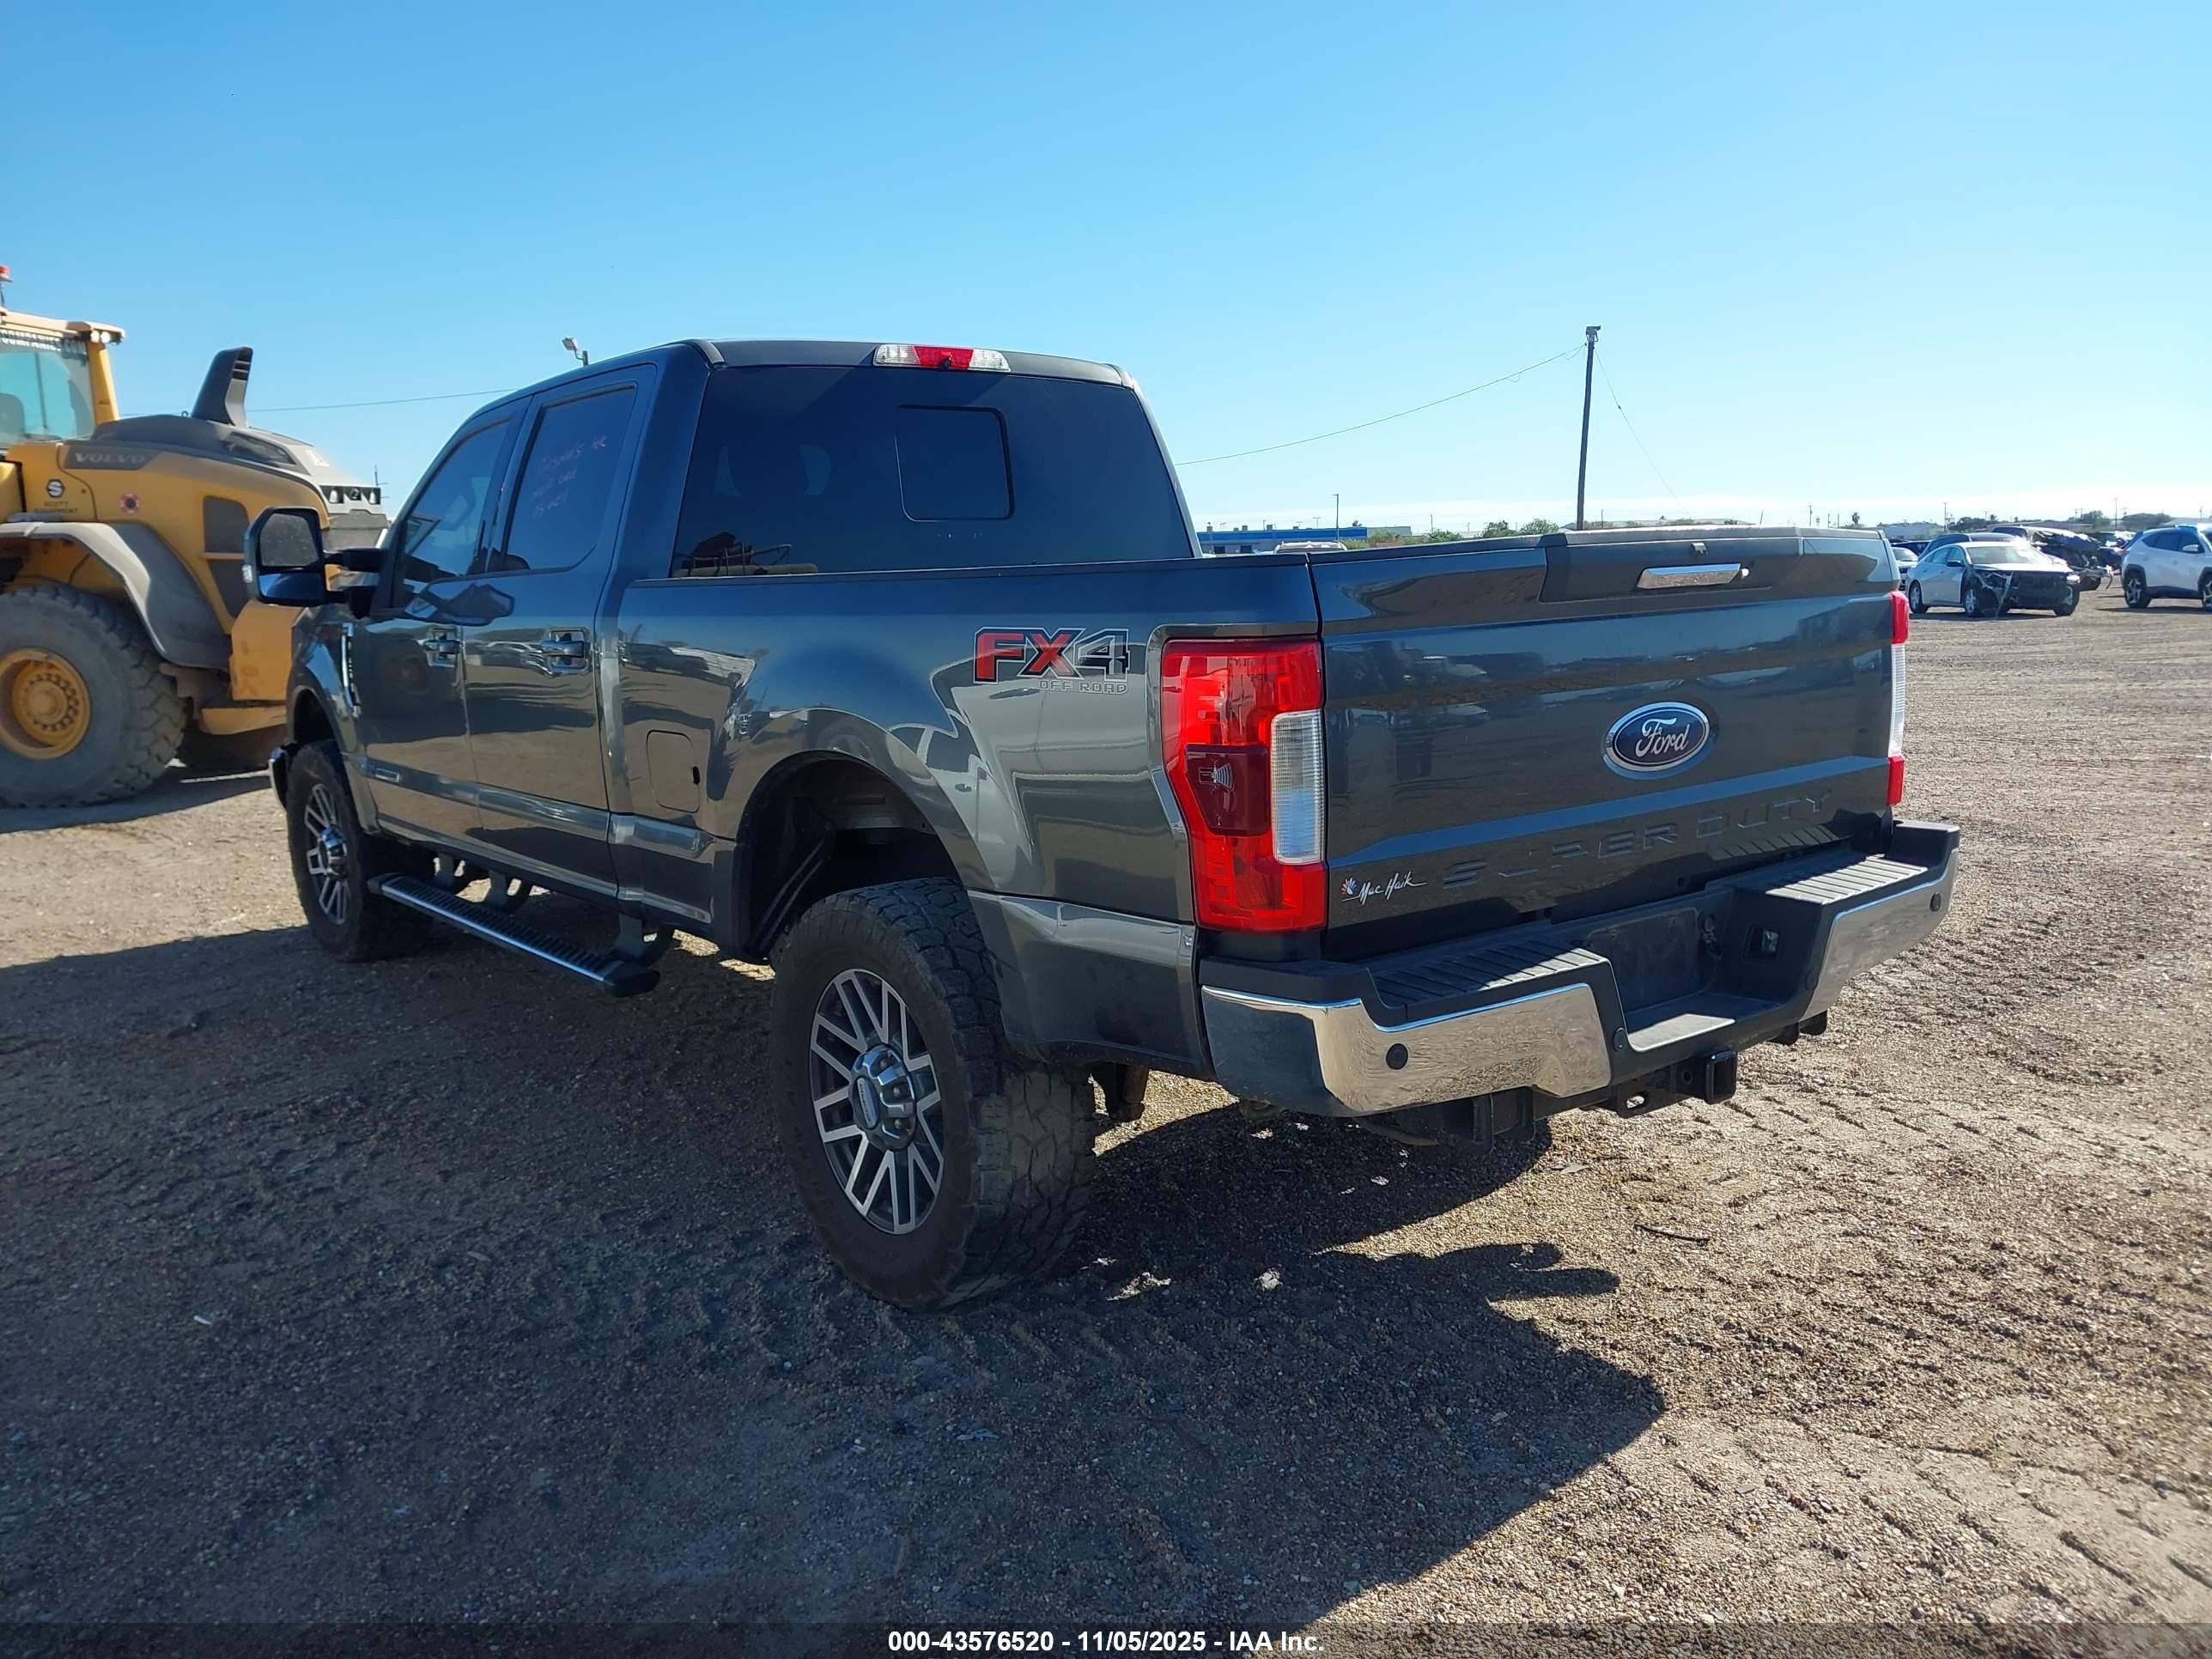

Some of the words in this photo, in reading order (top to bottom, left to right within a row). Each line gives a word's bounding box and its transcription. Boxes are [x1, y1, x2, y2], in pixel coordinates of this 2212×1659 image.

[75, 453, 145, 463] VOLVO
[974, 627, 1130, 684] FX4
[1040, 679, 1073, 692] OFF
[1079, 682, 1127, 695] ROAD
[1635, 718, 1691, 757] Ford
[1443, 822, 1677, 890] SUPER
[1696, 789, 1832, 839] DUTY
[1342, 881, 1384, 905] Mac
[1384, 871, 1427, 901] Haik
